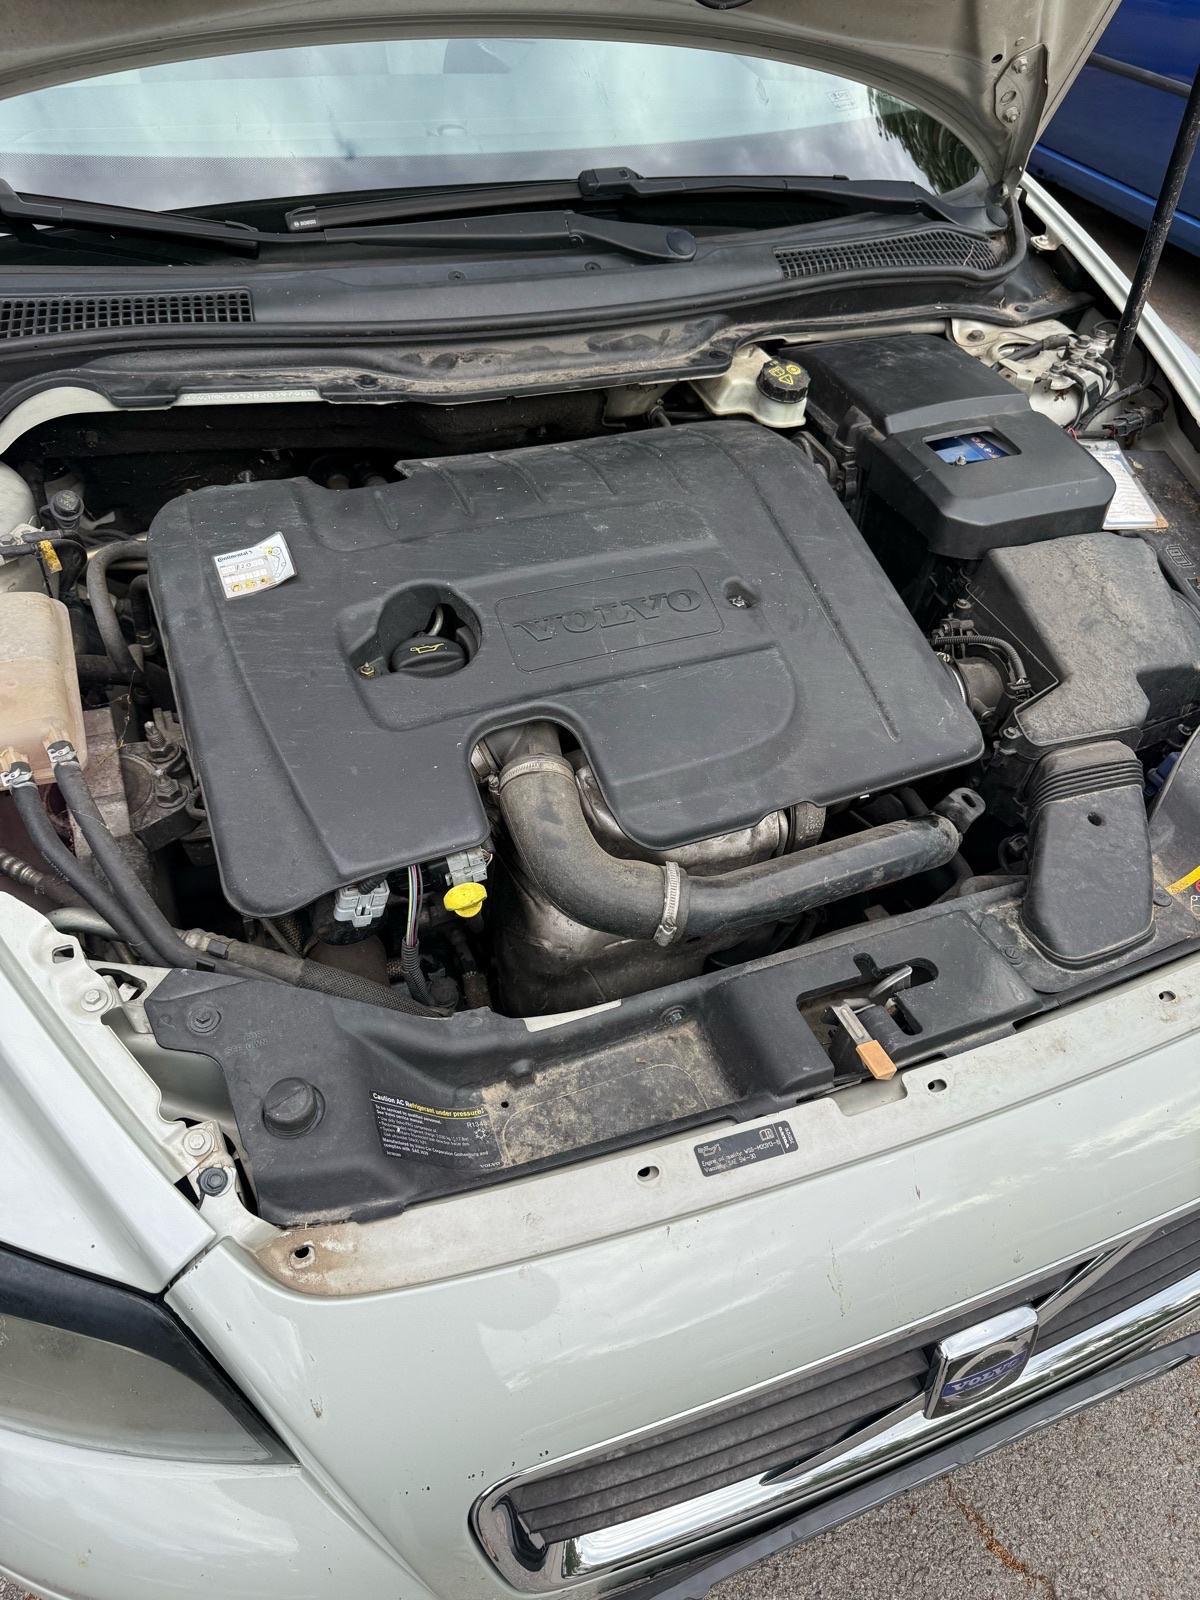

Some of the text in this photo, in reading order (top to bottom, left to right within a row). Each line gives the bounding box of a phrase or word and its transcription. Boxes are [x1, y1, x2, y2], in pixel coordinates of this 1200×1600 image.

[512, 588, 701, 642] VOLVO
[372, 1092, 485, 1118] Caution AC Refrigerant under pressure!
[951, 1358, 1019, 1391] VOLVO
